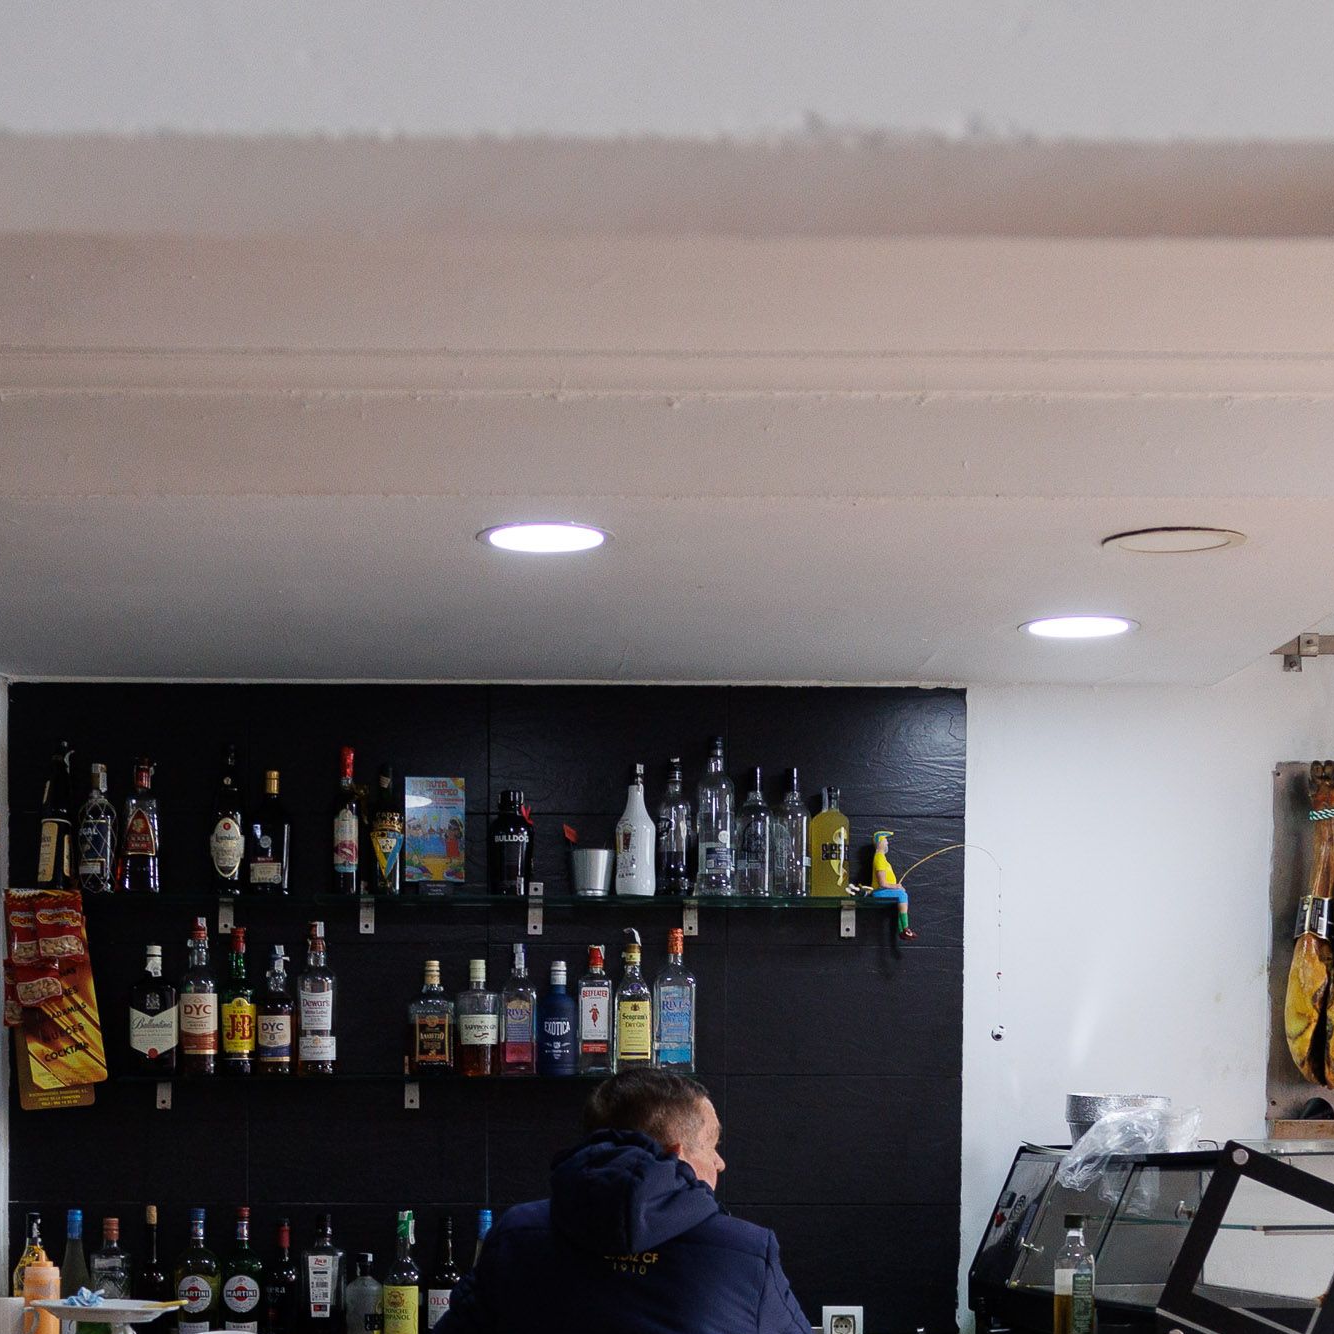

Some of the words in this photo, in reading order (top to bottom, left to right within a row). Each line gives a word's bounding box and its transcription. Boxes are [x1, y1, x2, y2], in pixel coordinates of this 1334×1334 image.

[494, 834, 530, 843] BULLDOG
[582, 989, 608, 998] BEEFEATER
[302, 998, 331, 1007] Dewar's
[183, 1003, 212, 1016] DYC
[131, 1016, 173, 1030] Ballantine's
[225, 1013, 254, 1041] J&B
[261, 1022, 284, 1032] DYC
[543, 1020, 571, 1037] EXOTICA
[641, 1252, 659, 1264] CF
[613, 1262, 648, 1276] 1910
[179, 1289, 210, 1298] MARTINI
[226, 1289, 258, 1298] MARTINI
